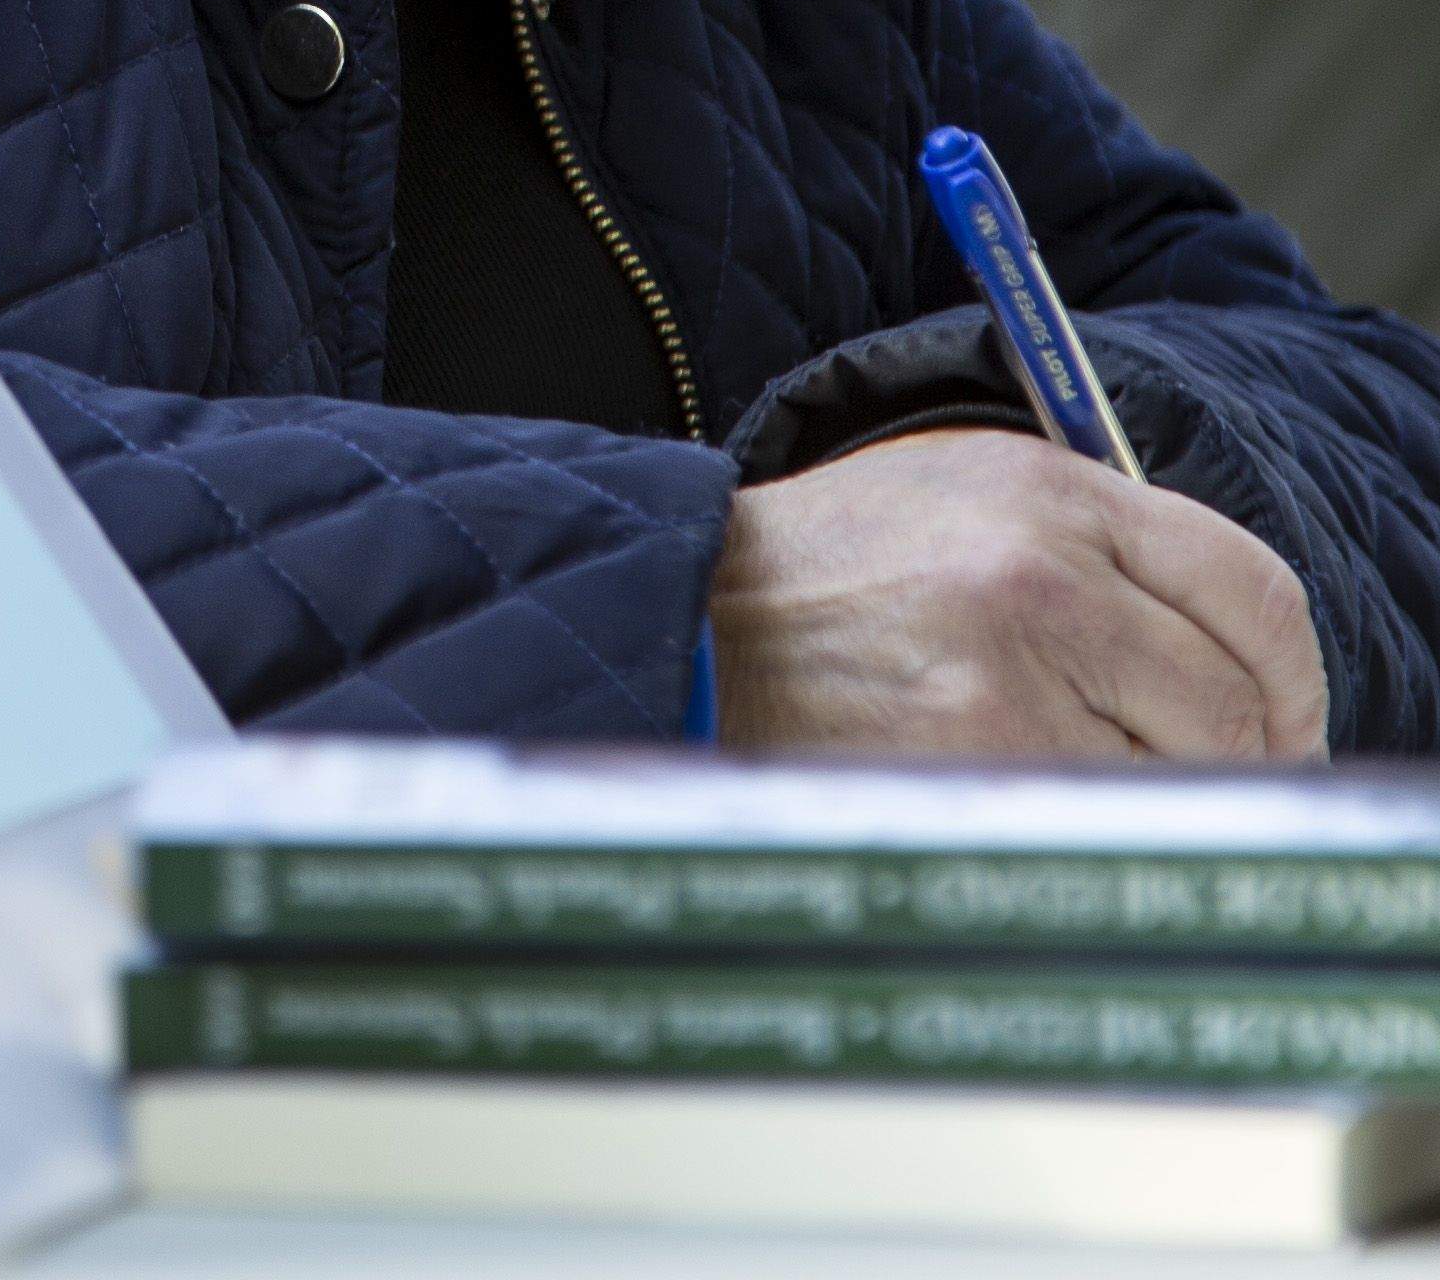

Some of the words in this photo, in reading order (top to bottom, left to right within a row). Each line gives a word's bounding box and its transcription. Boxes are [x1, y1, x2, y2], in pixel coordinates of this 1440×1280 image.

[992, 244, 1024, 287] GRIP
[1013, 289, 1053, 345] SUPER
[1039, 349, 1078, 401] PILOT
